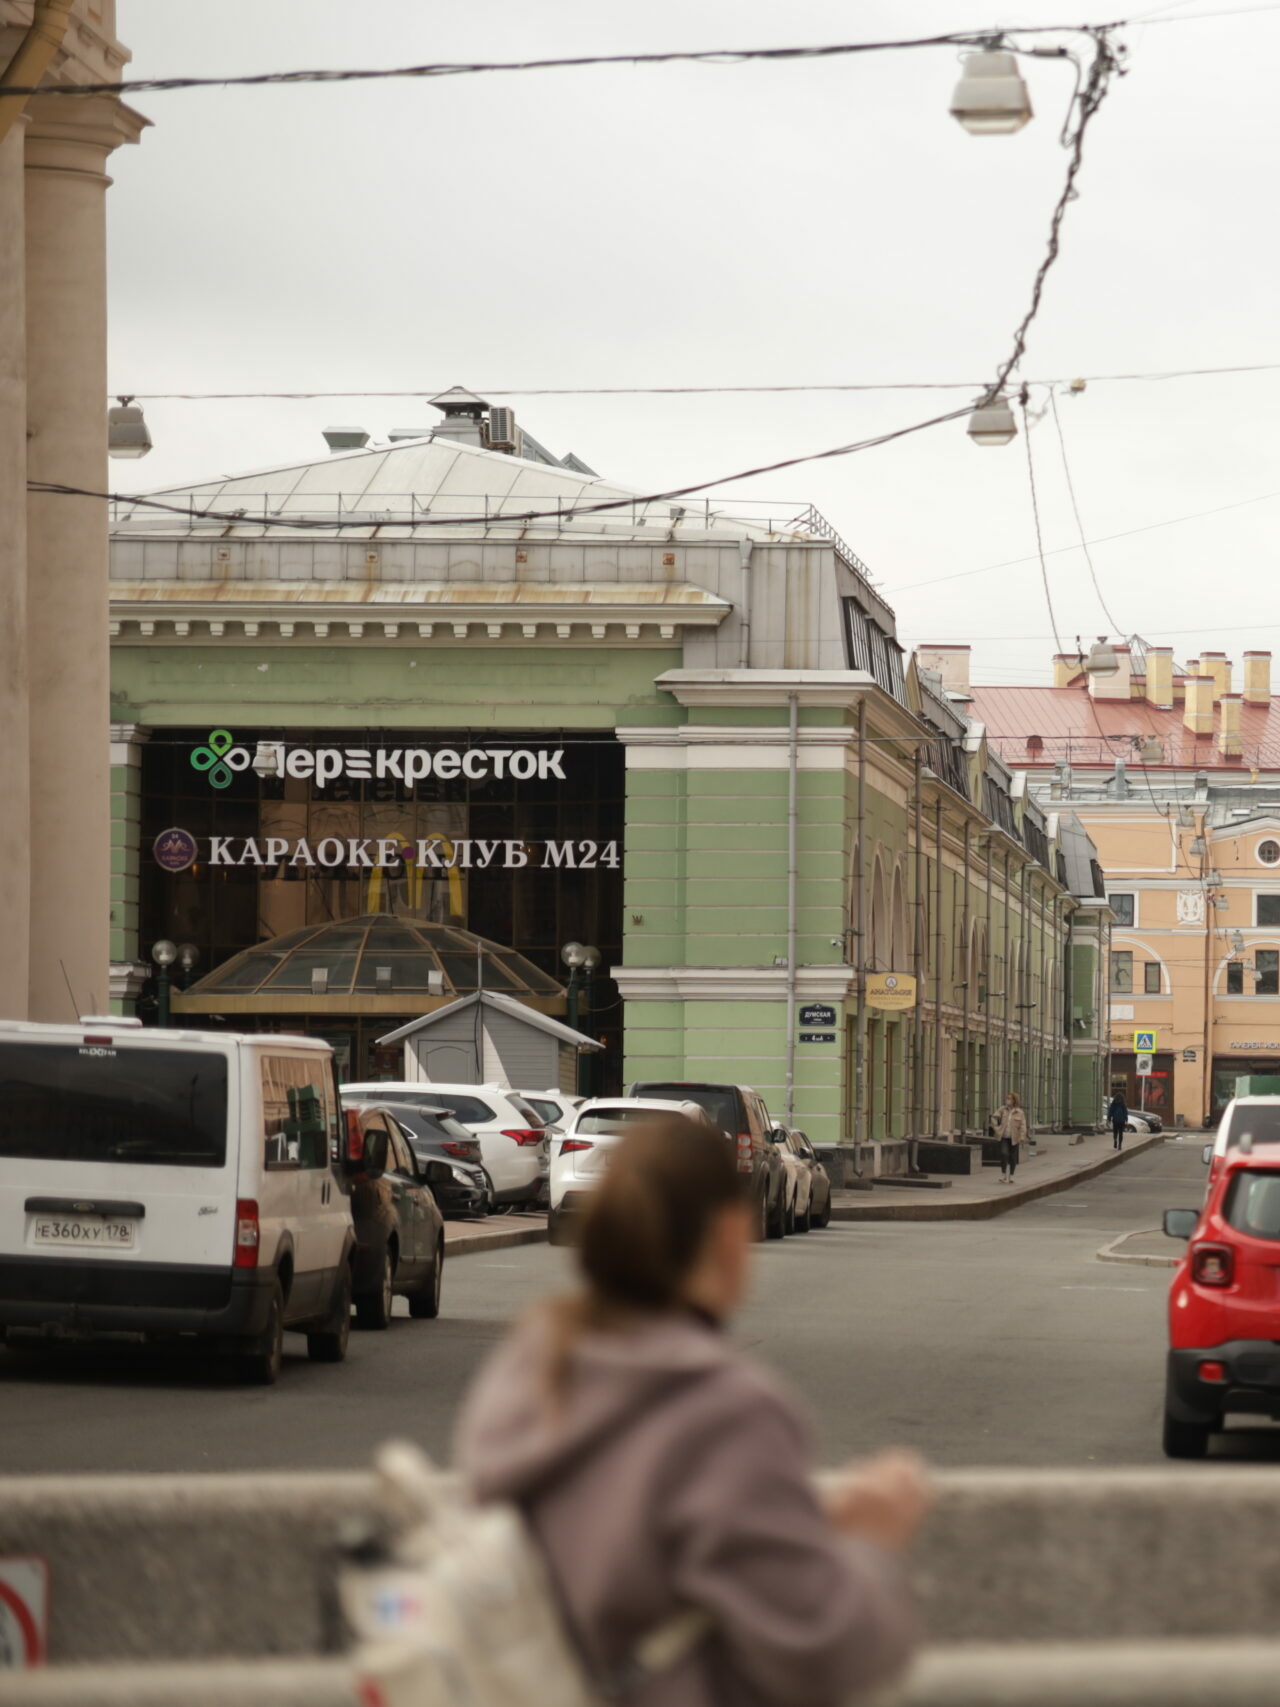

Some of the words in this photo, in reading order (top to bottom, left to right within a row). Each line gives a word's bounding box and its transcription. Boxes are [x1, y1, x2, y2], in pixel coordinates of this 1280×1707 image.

[208, 837, 399, 867] КАРАОКЕ
[416, 839, 529, 869] КЛУБ
[541, 839, 621, 870] М24
[105, 1223, 128, 1238] 178
